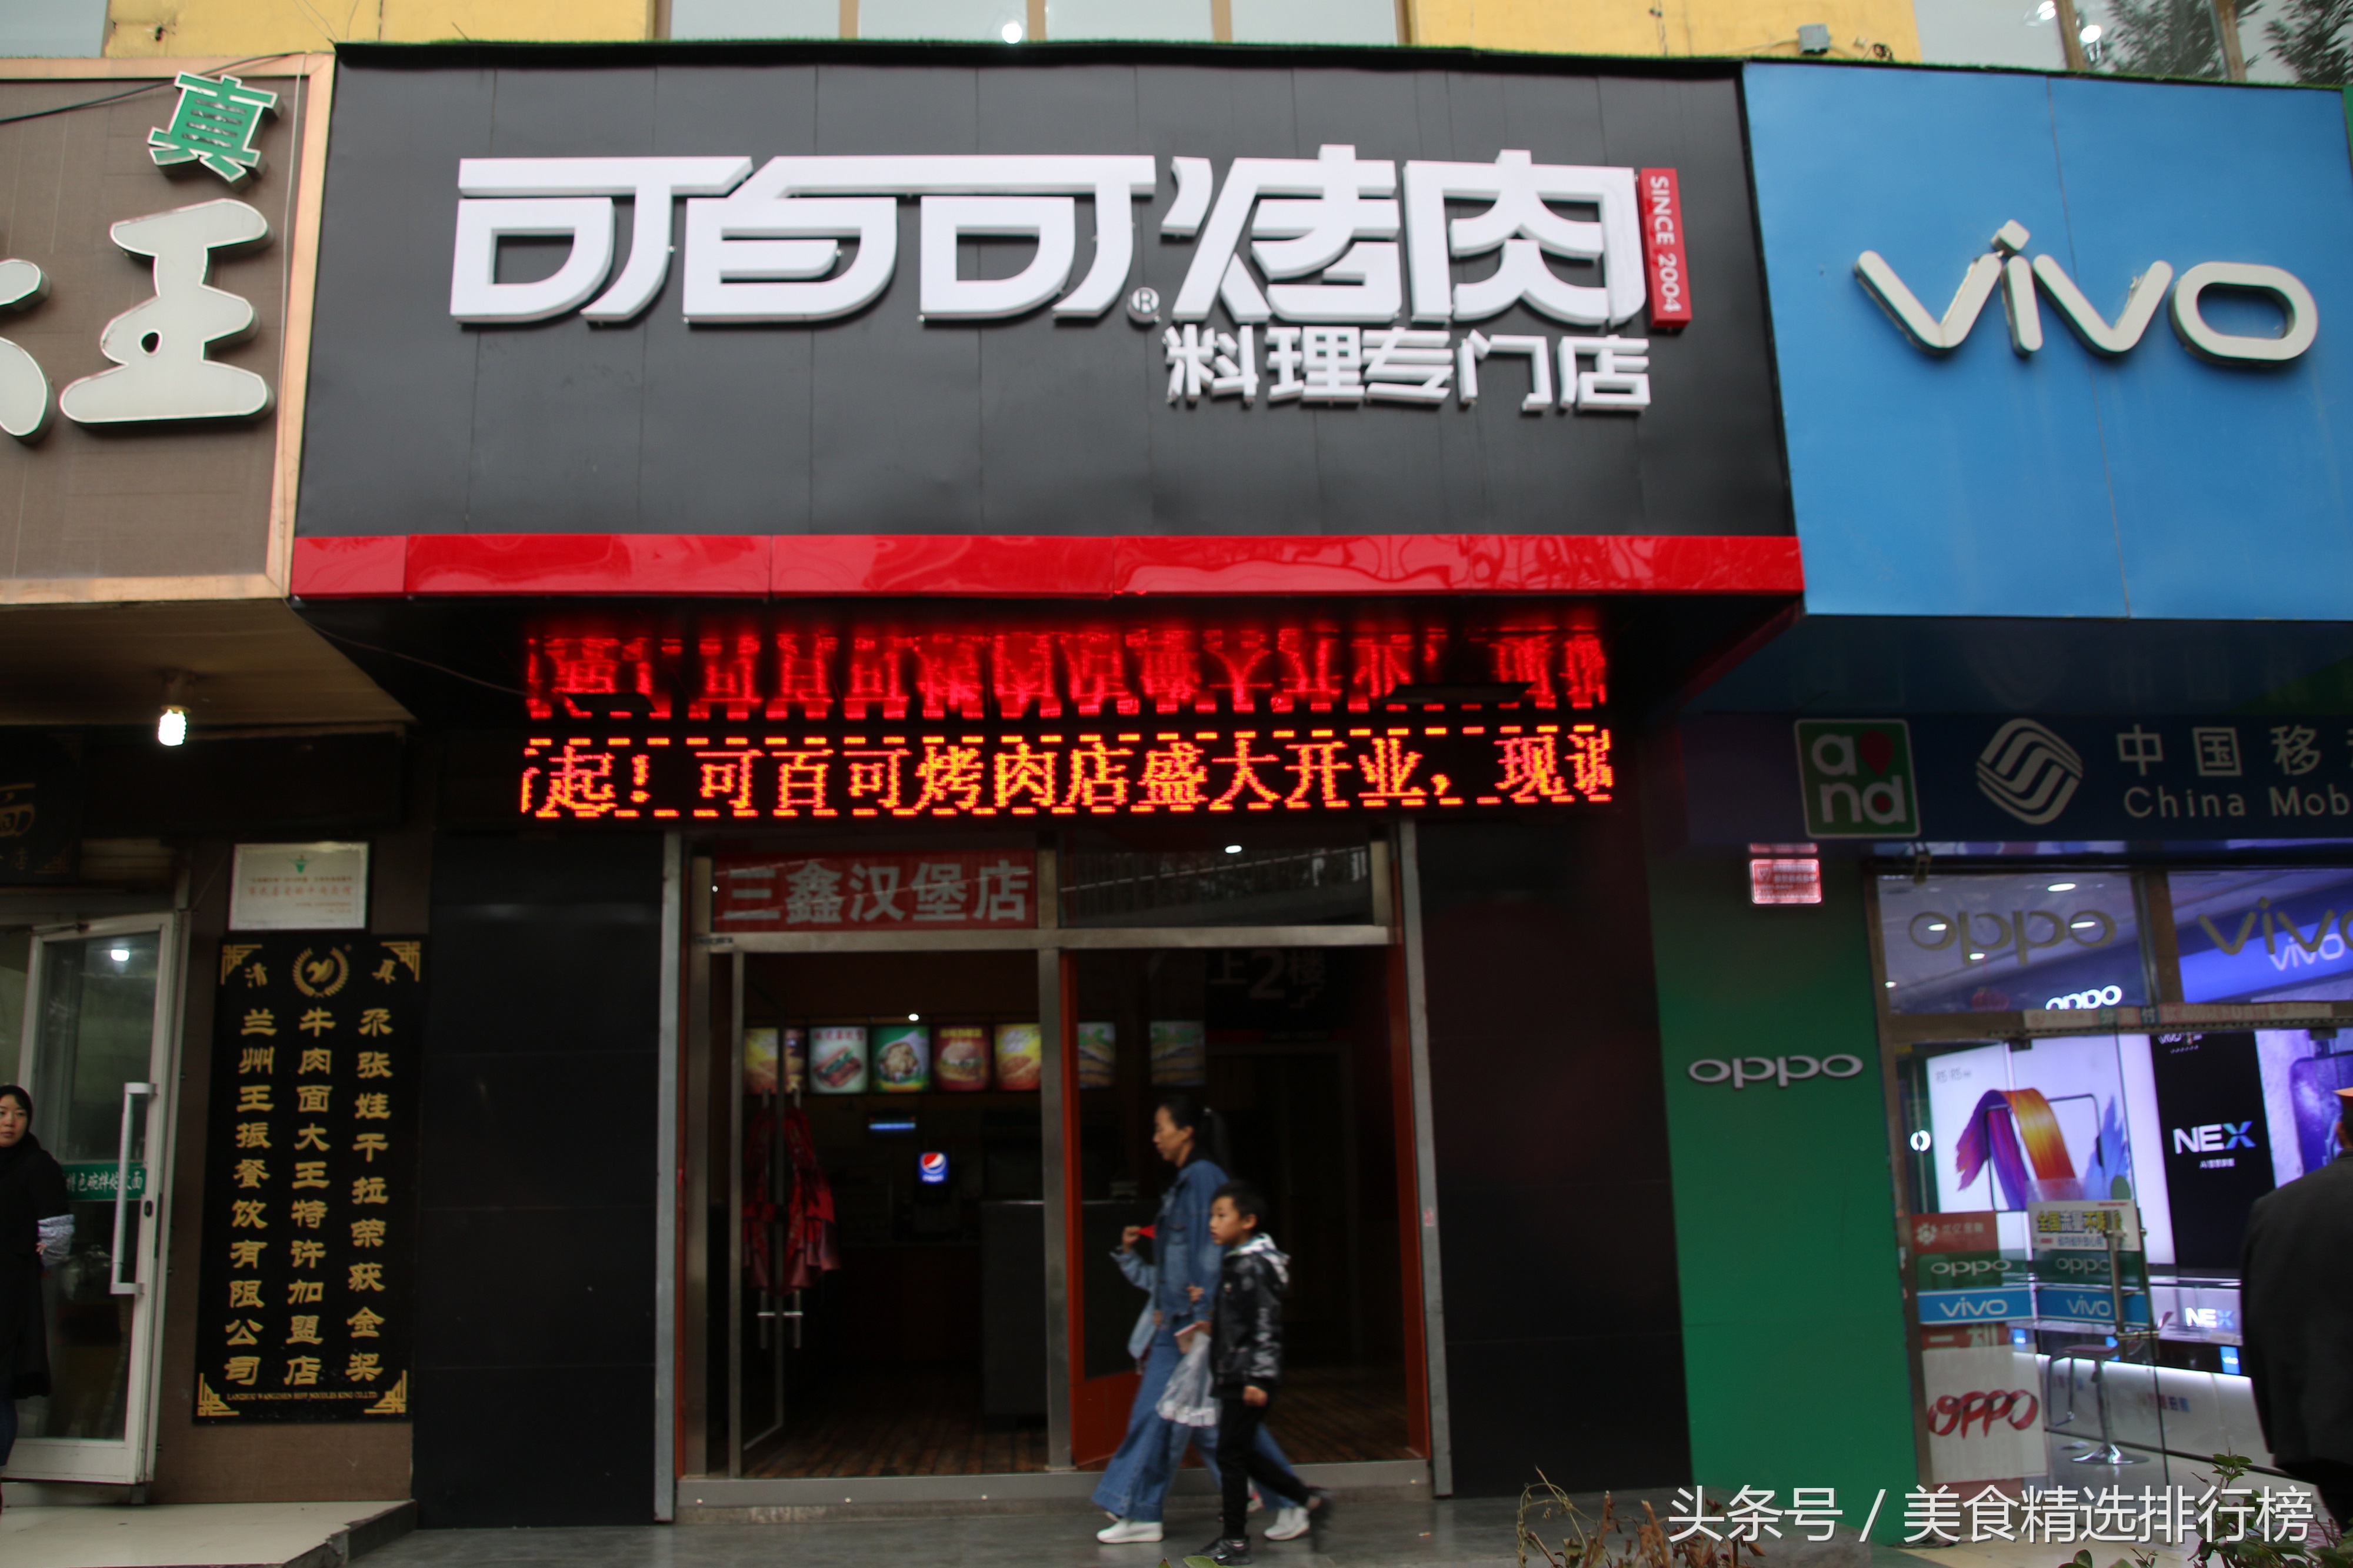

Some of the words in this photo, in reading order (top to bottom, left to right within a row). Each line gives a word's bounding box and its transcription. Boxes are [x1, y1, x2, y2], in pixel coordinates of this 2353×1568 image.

[1649, 174, 1676, 246] SINCE
[1656, 252, 1682, 314] 2004
[1854, 219, 2318, 361] vivo
[1163, 324, 1651, 412] 料理专门店
[2116, 723, 2353, 777] 中国移
[2124, 785, 2246, 818] China
[723, 859, 1032, 923] 三鑫汉堡店
[1909, 910, 2117, 966] oppo
[2198, 896, 2353, 956] viv
[1688, 1053, 1864, 1089] oppo
[2173, 1120, 2257, 1155] NEX
[223, 1007, 279, 1386] 兰州王振餐饮有限公司
[283, 1005, 338, 1386] 牛肉面大王特许加盟店
[1931, 1259, 2012, 1277] oppo
[1939, 1297, 2008, 1317] vivo
[2067, 1295, 2112, 1317] vivo
[2185, 1307, 2235, 1329] NEX
